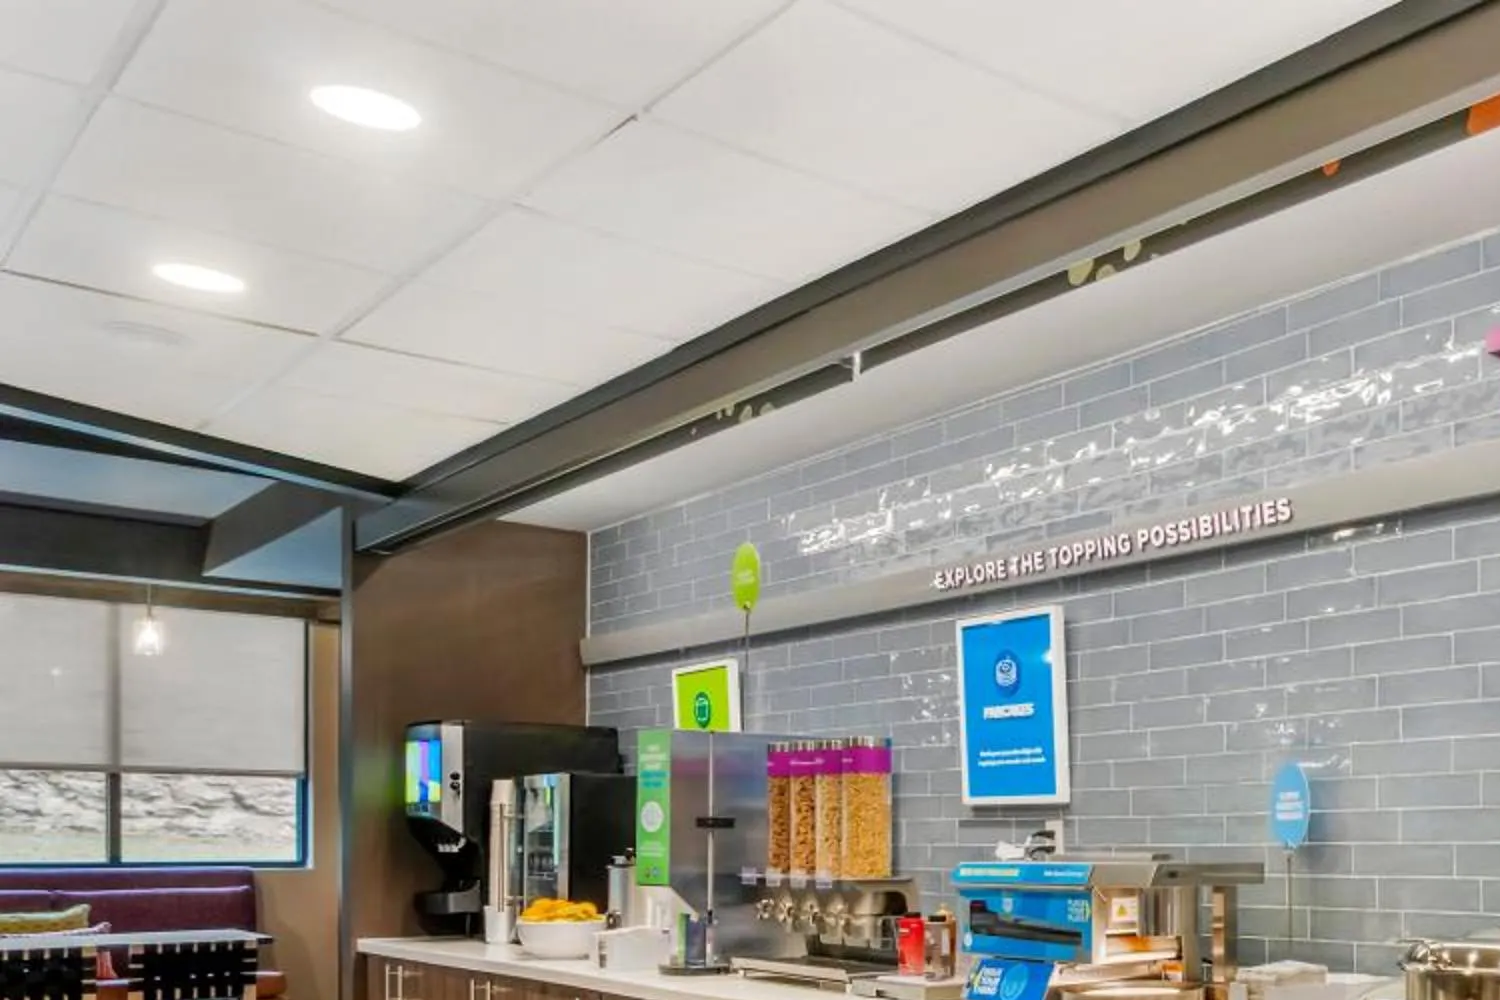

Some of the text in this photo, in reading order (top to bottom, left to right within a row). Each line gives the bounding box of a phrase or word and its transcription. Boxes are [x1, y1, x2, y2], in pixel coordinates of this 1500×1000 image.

[934, 497, 1293, 590] EXPLORE THE TOPPING POSSIBILITIES
